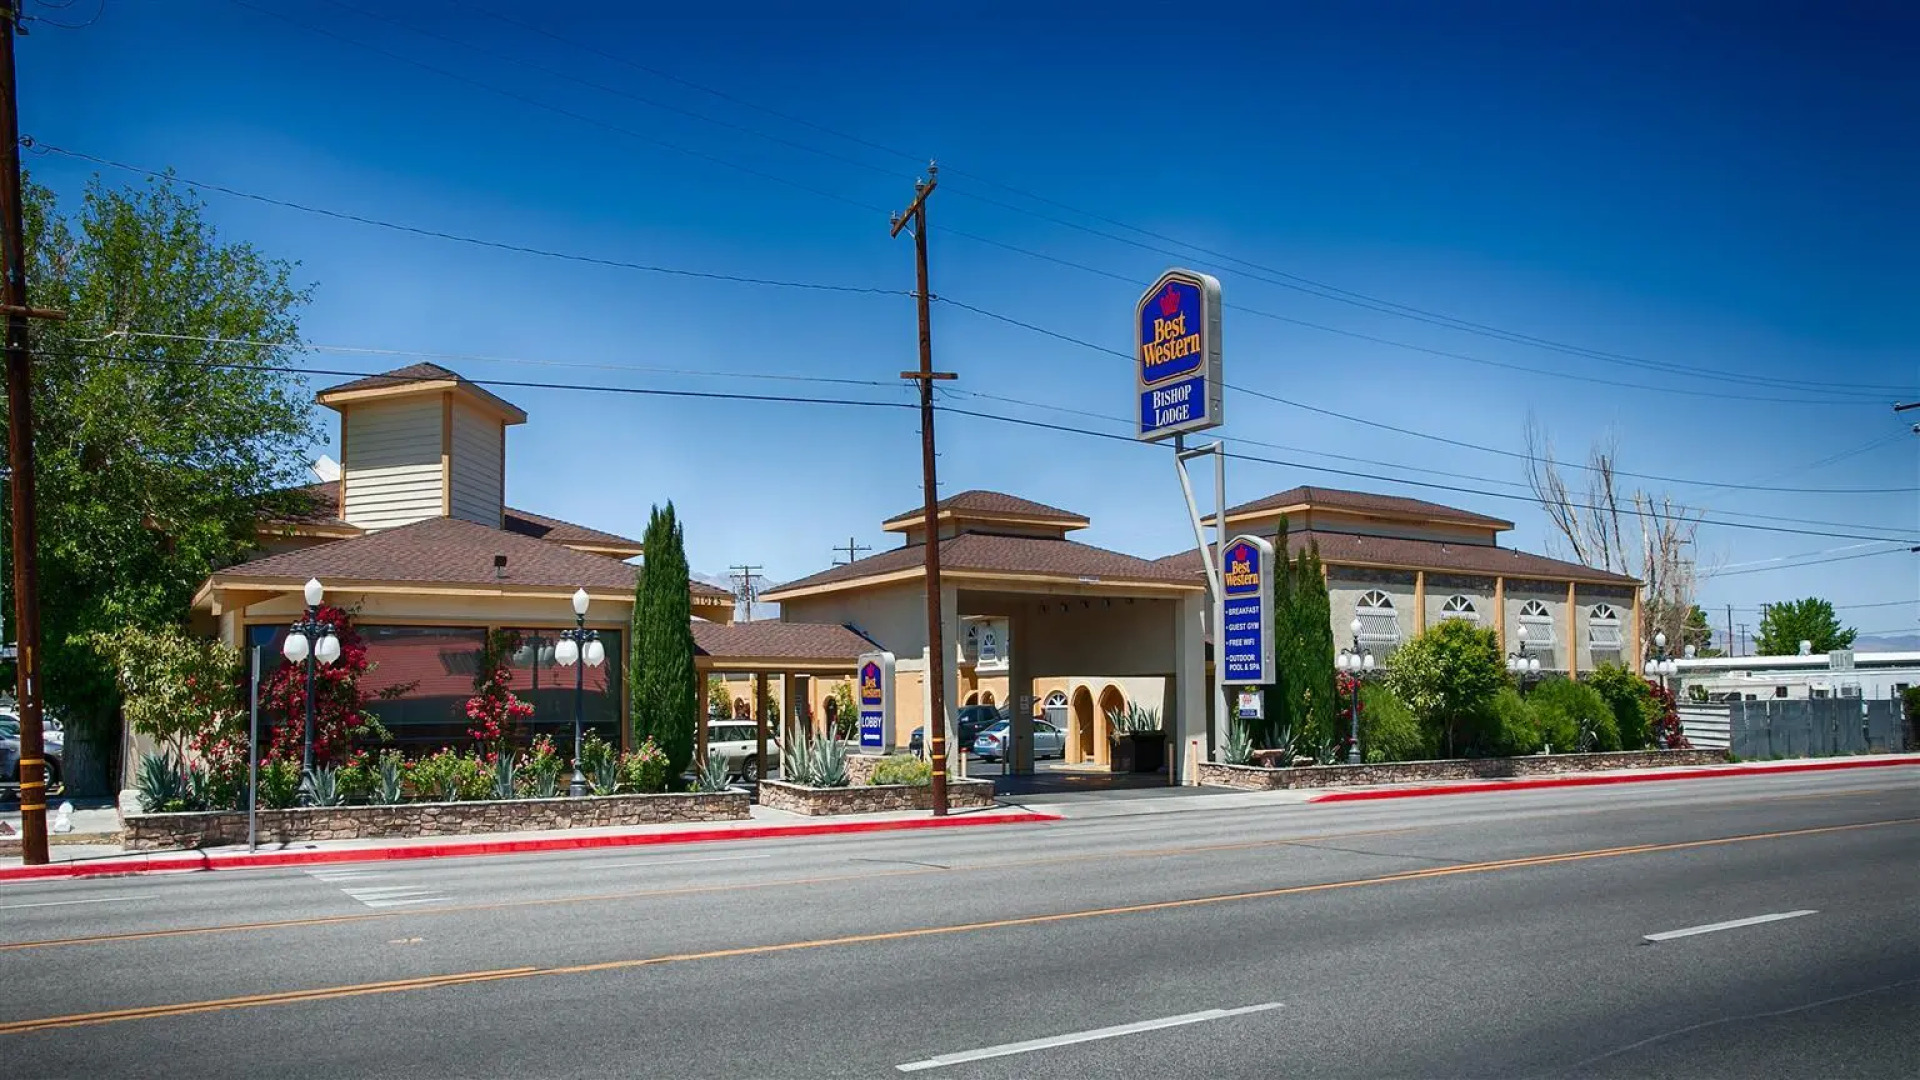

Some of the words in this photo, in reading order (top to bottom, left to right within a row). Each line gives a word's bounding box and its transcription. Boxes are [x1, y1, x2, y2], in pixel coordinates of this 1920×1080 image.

[1154, 310, 1186, 344] Best
[1142, 333, 1200, 367] Western
[1153, 385, 1192, 410] BISHOP
[1155, 404, 1190, 427] LODGE
[1232, 560, 1250, 575] Best
[1225, 573, 1259, 586] Western
[1228, 605, 1260, 616] BREAKFAST
[1229, 623, 1246, 631] GUEST
[1246, 622, 1260, 630] GYM
[1229, 654, 1256, 662] OUTDOOR
[1229, 663, 1243, 671] POOL
[861, 716, 882, 728] LOBBY
